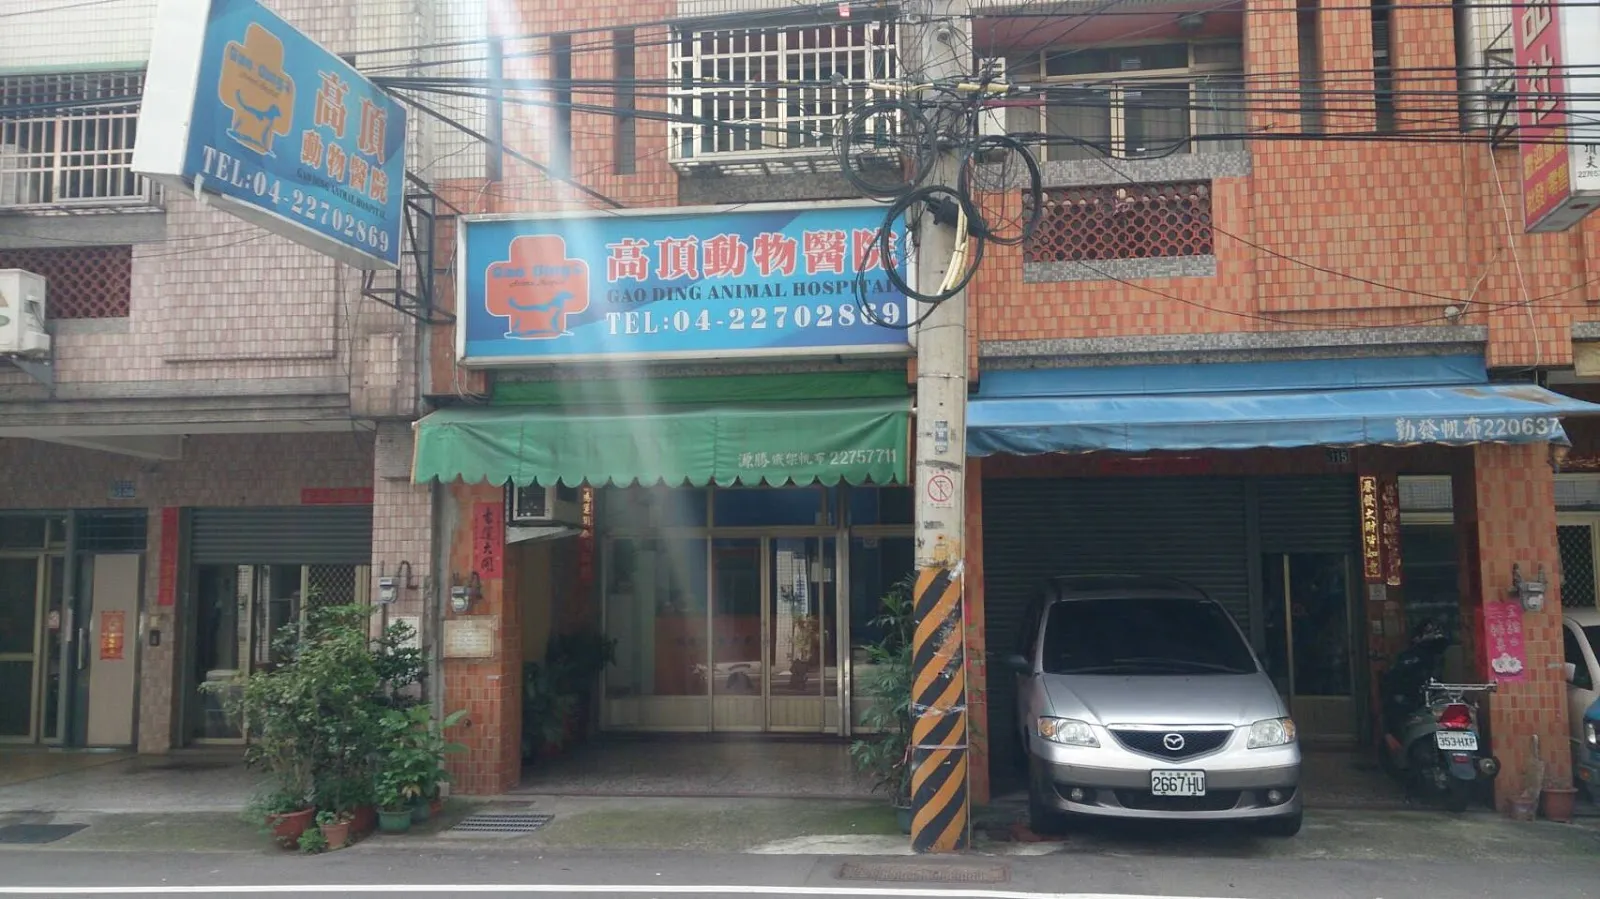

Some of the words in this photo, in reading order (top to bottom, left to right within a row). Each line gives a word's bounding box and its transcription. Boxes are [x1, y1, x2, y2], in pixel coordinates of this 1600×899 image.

[316, 69, 387, 165] 高頂
[301, 129, 388, 204] 動物醫院
[202, 145, 390, 253] TEL:04-22702869
[605, 228, 899, 282] 高頂動物醫院
[607, 287, 647, 303] GAO
[652, 287, 701, 301] DING
[708, 282, 787, 299] ANIMAL
[793, 279, 899, 296] HOSPITAL
[605, 302, 900, 335] TEL:04-22702869
[1396, 416, 1481, 441] 勤發帆布
[1484, 417, 1562, 436] 220637
[829, 449, 897, 465] 22757711
